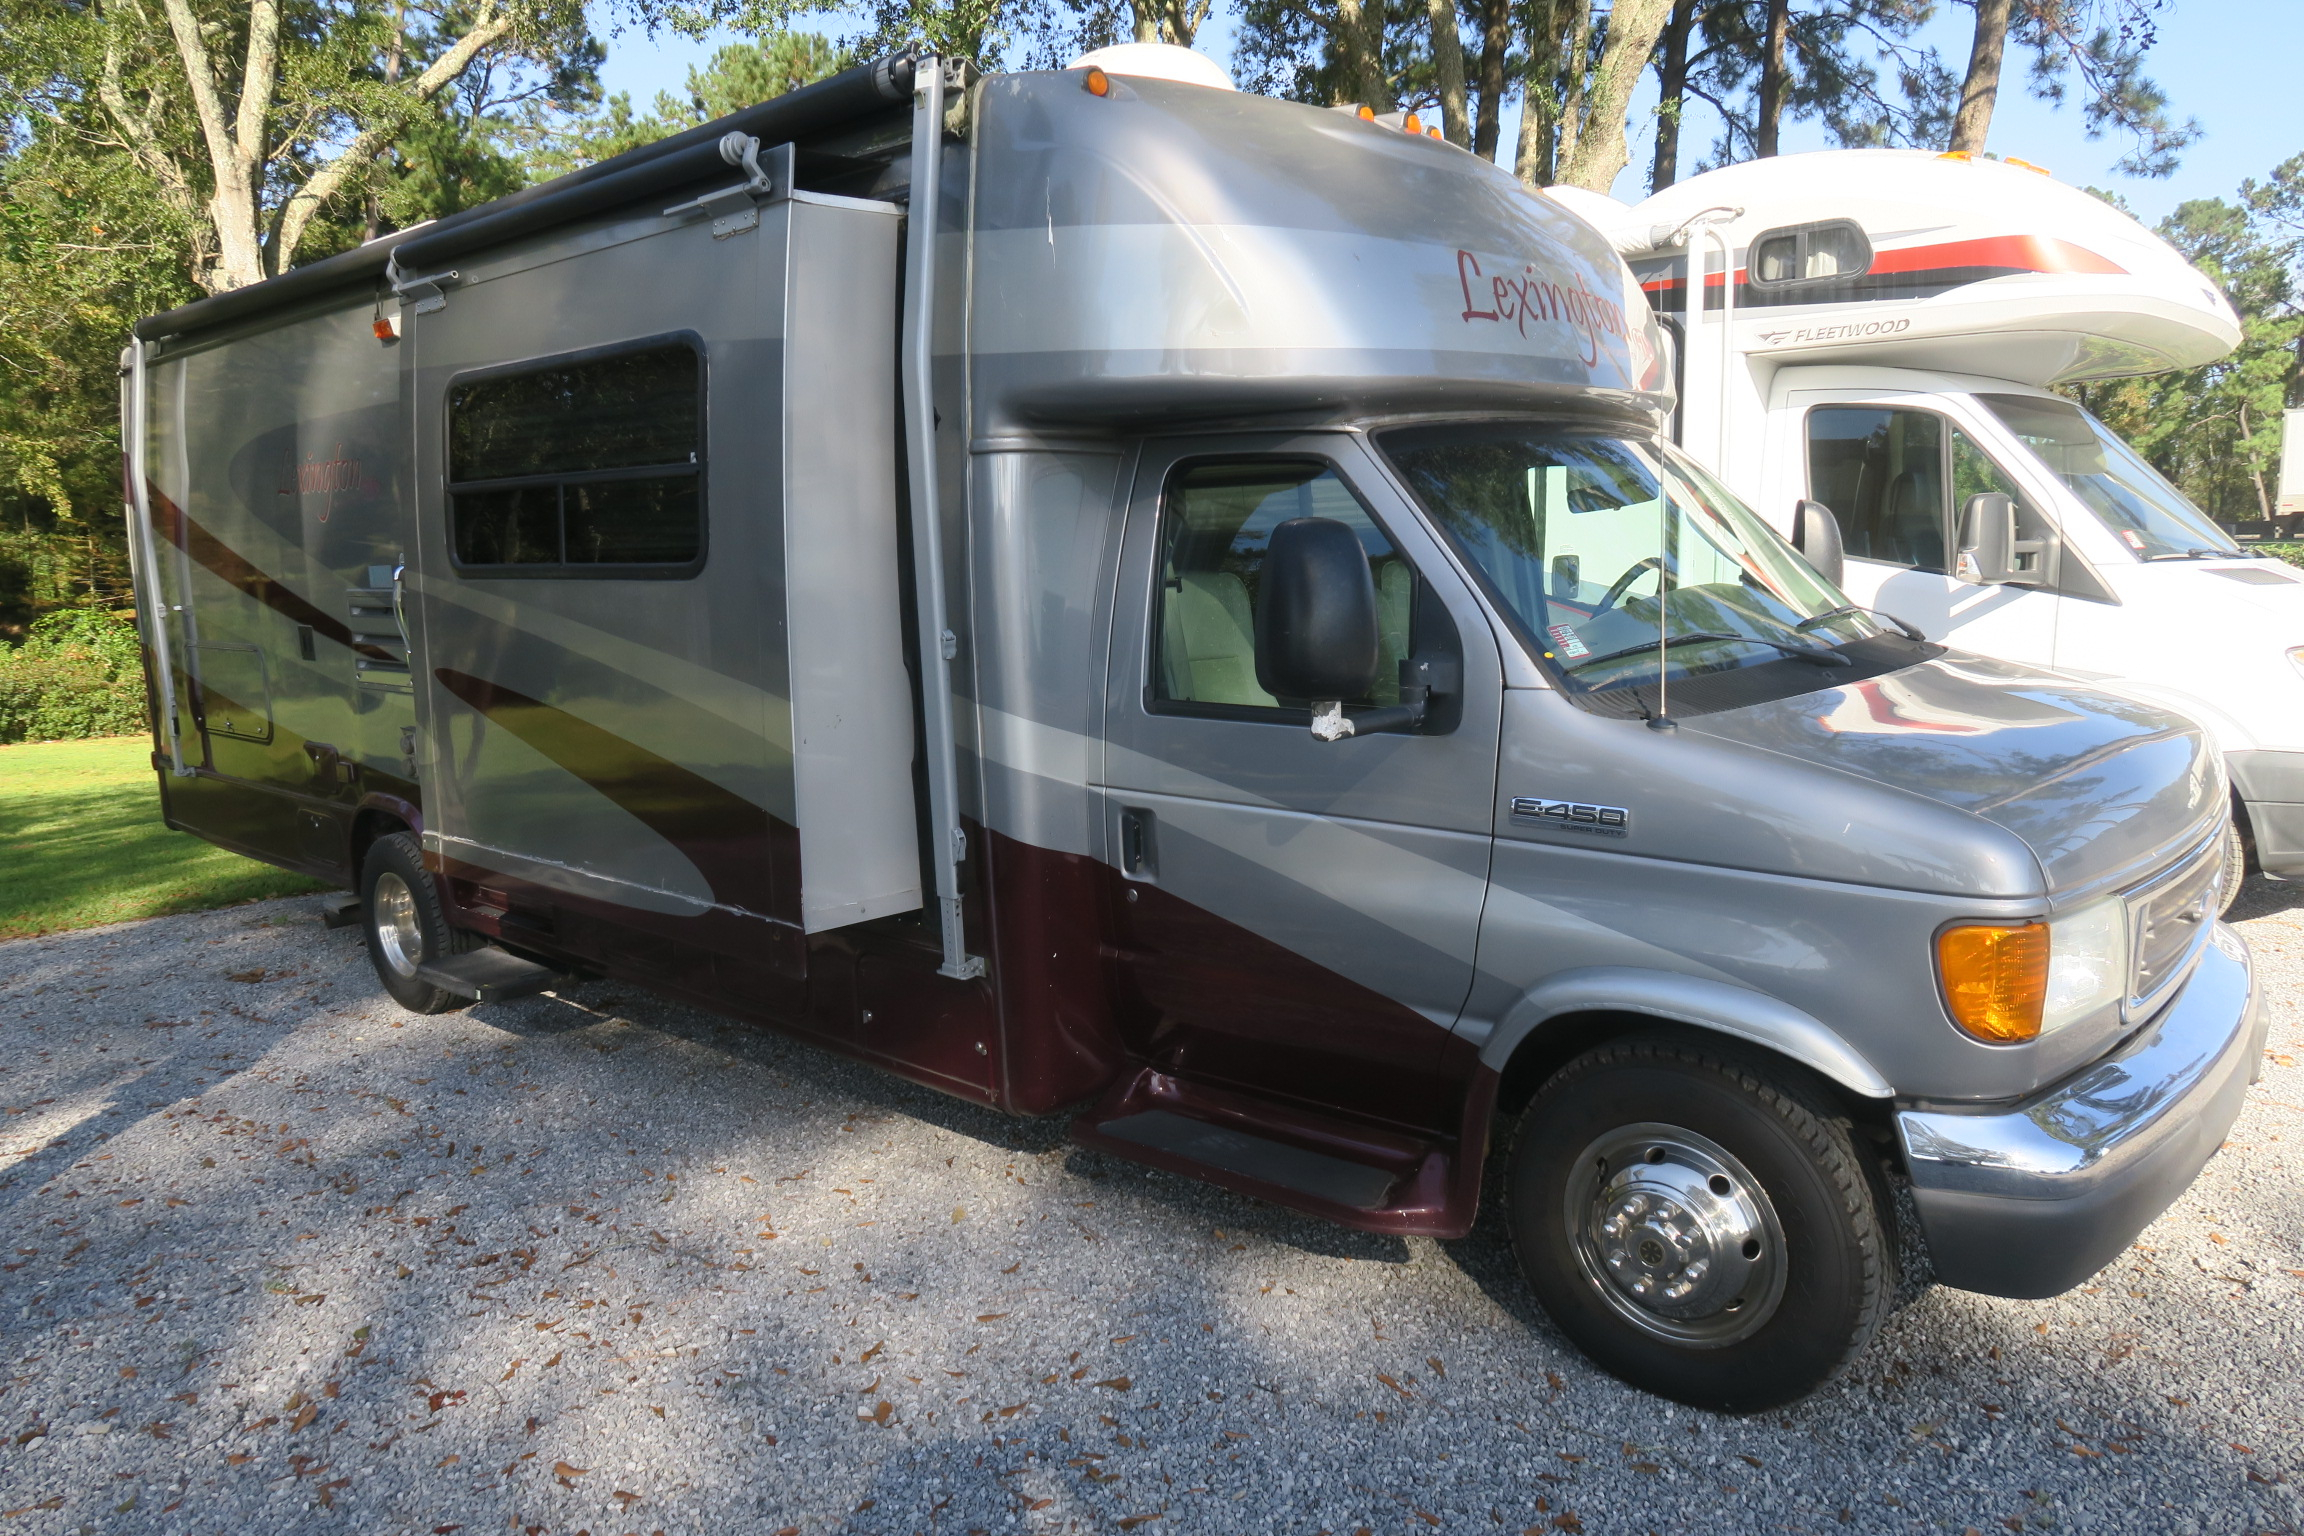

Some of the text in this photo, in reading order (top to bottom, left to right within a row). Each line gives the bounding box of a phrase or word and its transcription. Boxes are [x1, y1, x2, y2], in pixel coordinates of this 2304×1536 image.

[1457, 249, 1631, 368] Lexington
[1793, 318, 1910, 342] FLEETWOOD
[1513, 798, 1626, 827] E-450
[1560, 823, 1622, 837] SUPER DUTY
